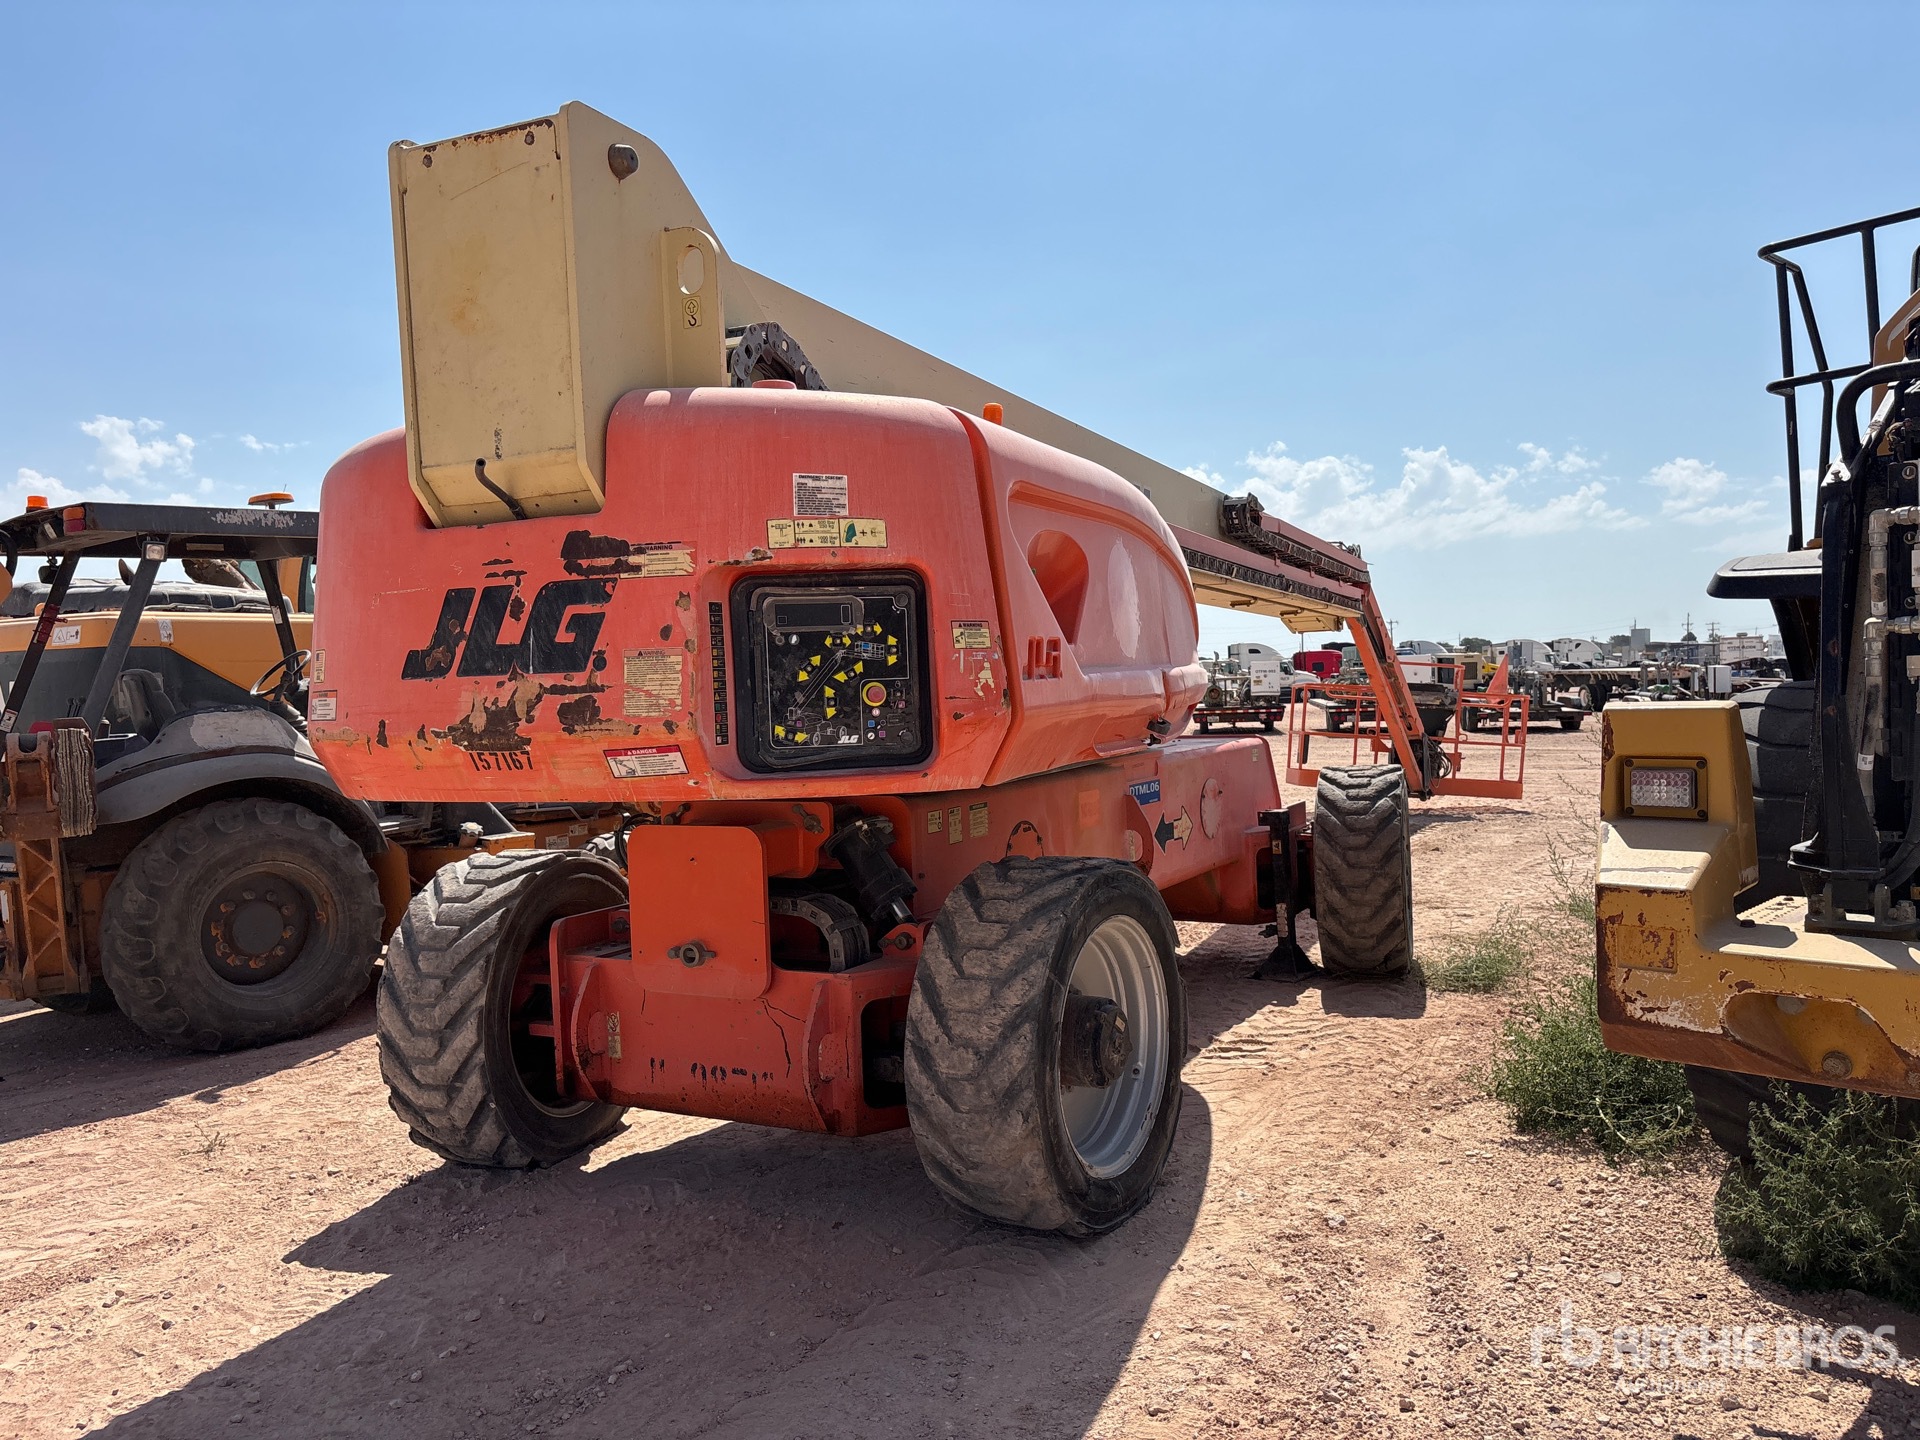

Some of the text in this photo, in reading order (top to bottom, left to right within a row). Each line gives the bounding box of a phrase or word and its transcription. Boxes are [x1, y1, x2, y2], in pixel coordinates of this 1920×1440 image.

[401, 577, 618, 681] JLG
[837, 734, 859, 744] JLG
[468, 751, 533, 771] 157167
[1129, 781, 1160, 796] DTML06
